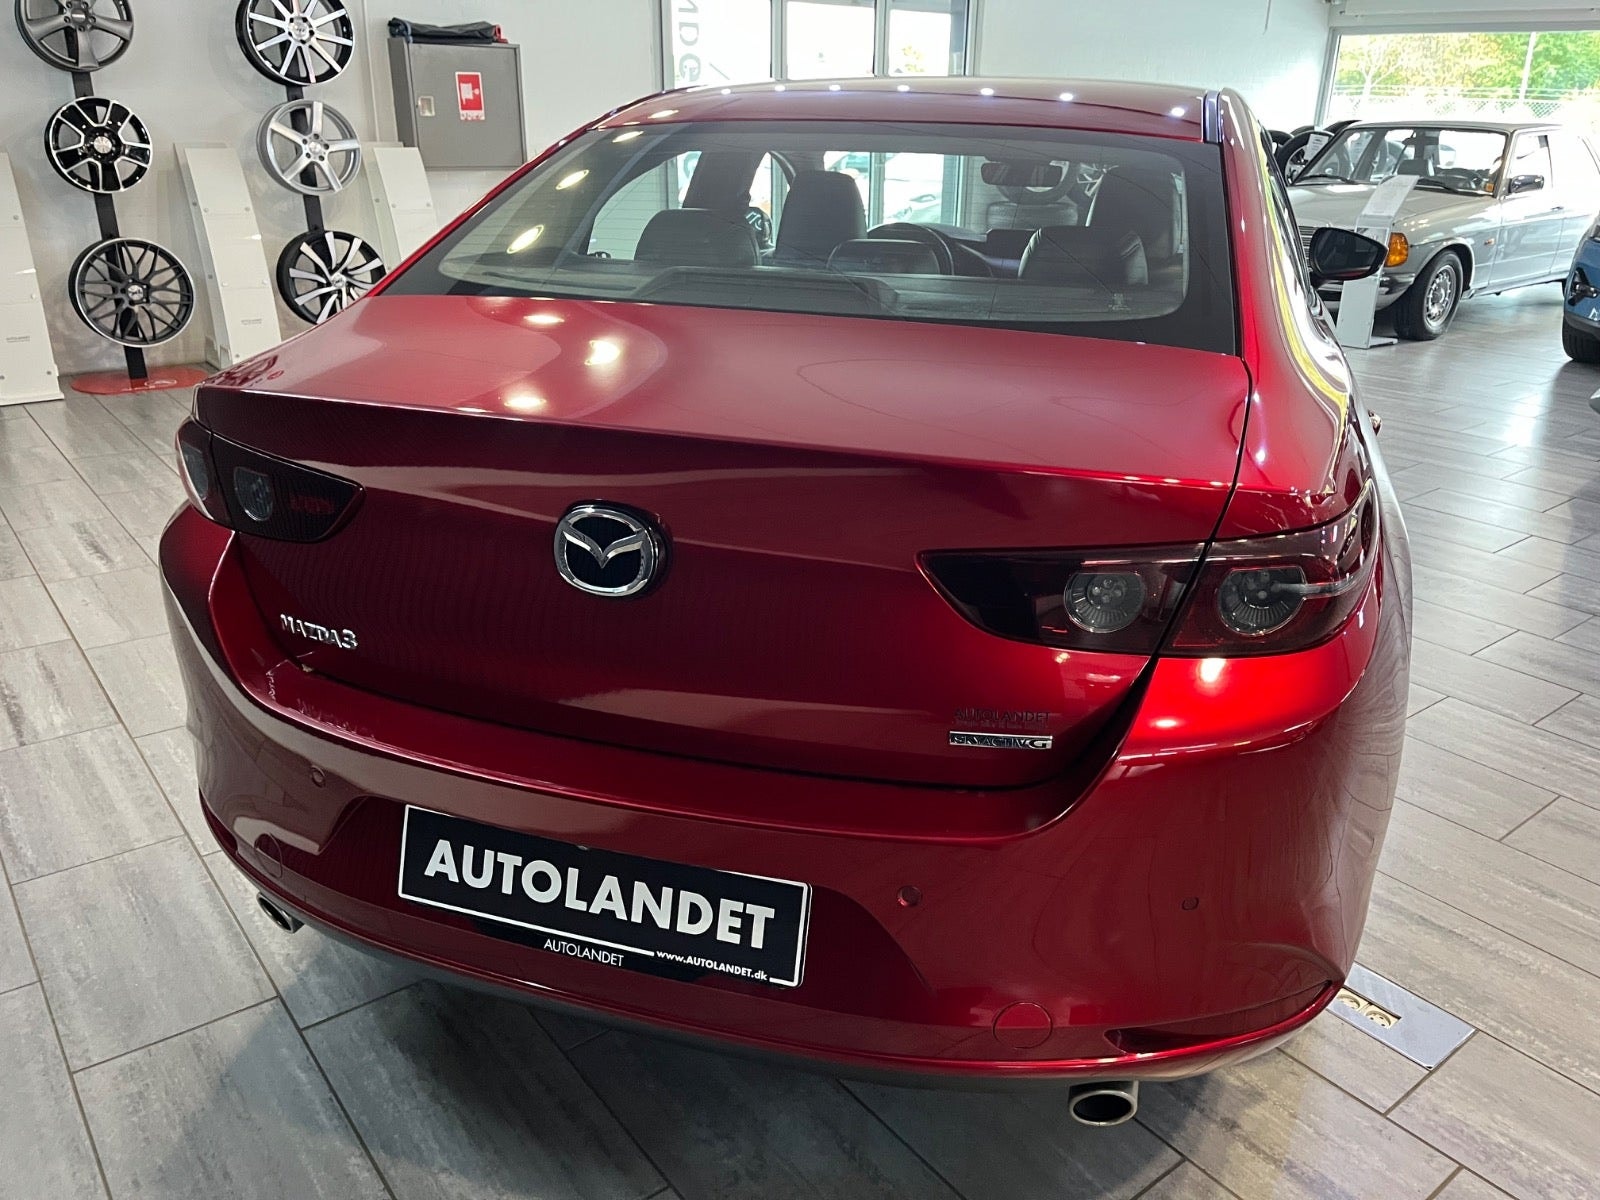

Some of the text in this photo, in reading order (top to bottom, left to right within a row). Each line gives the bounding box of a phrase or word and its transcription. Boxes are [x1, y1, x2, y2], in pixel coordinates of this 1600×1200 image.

[424, 839, 775, 949] AUTOLANDET
[543, 938, 625, 967] AUTOLANDET
[656, 950, 768, 981] www.AUTOLANDET.dk
